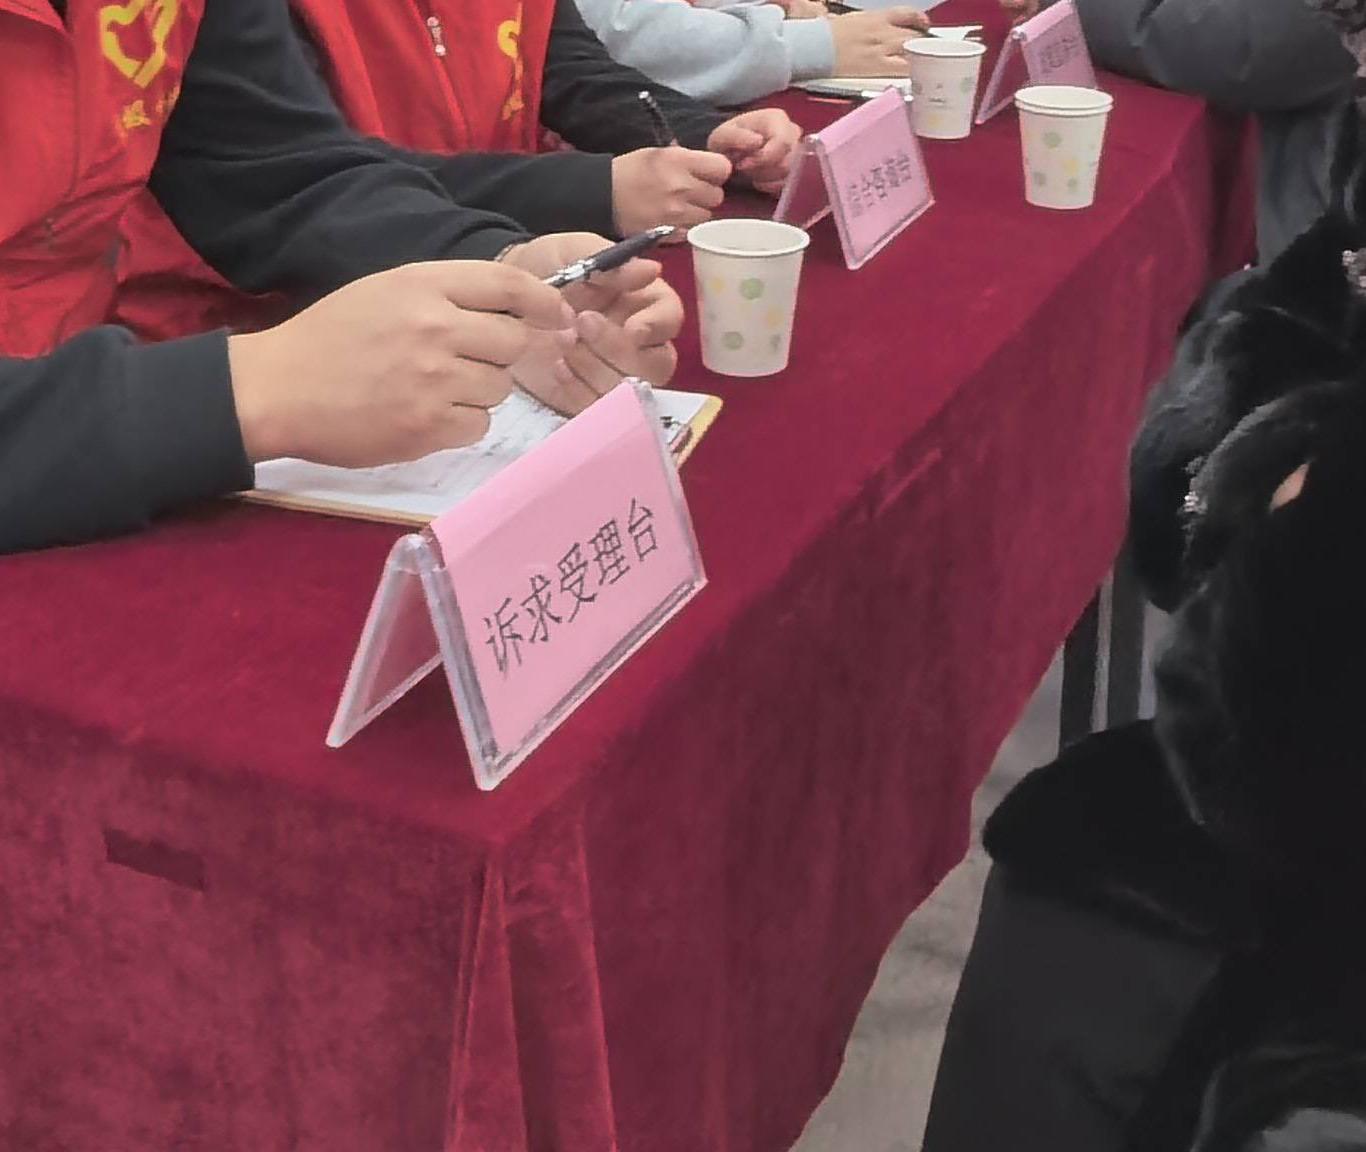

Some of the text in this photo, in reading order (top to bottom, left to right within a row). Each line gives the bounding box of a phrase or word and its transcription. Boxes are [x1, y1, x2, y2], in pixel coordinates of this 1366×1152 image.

[483, 498, 659, 675] 诉求受理台
